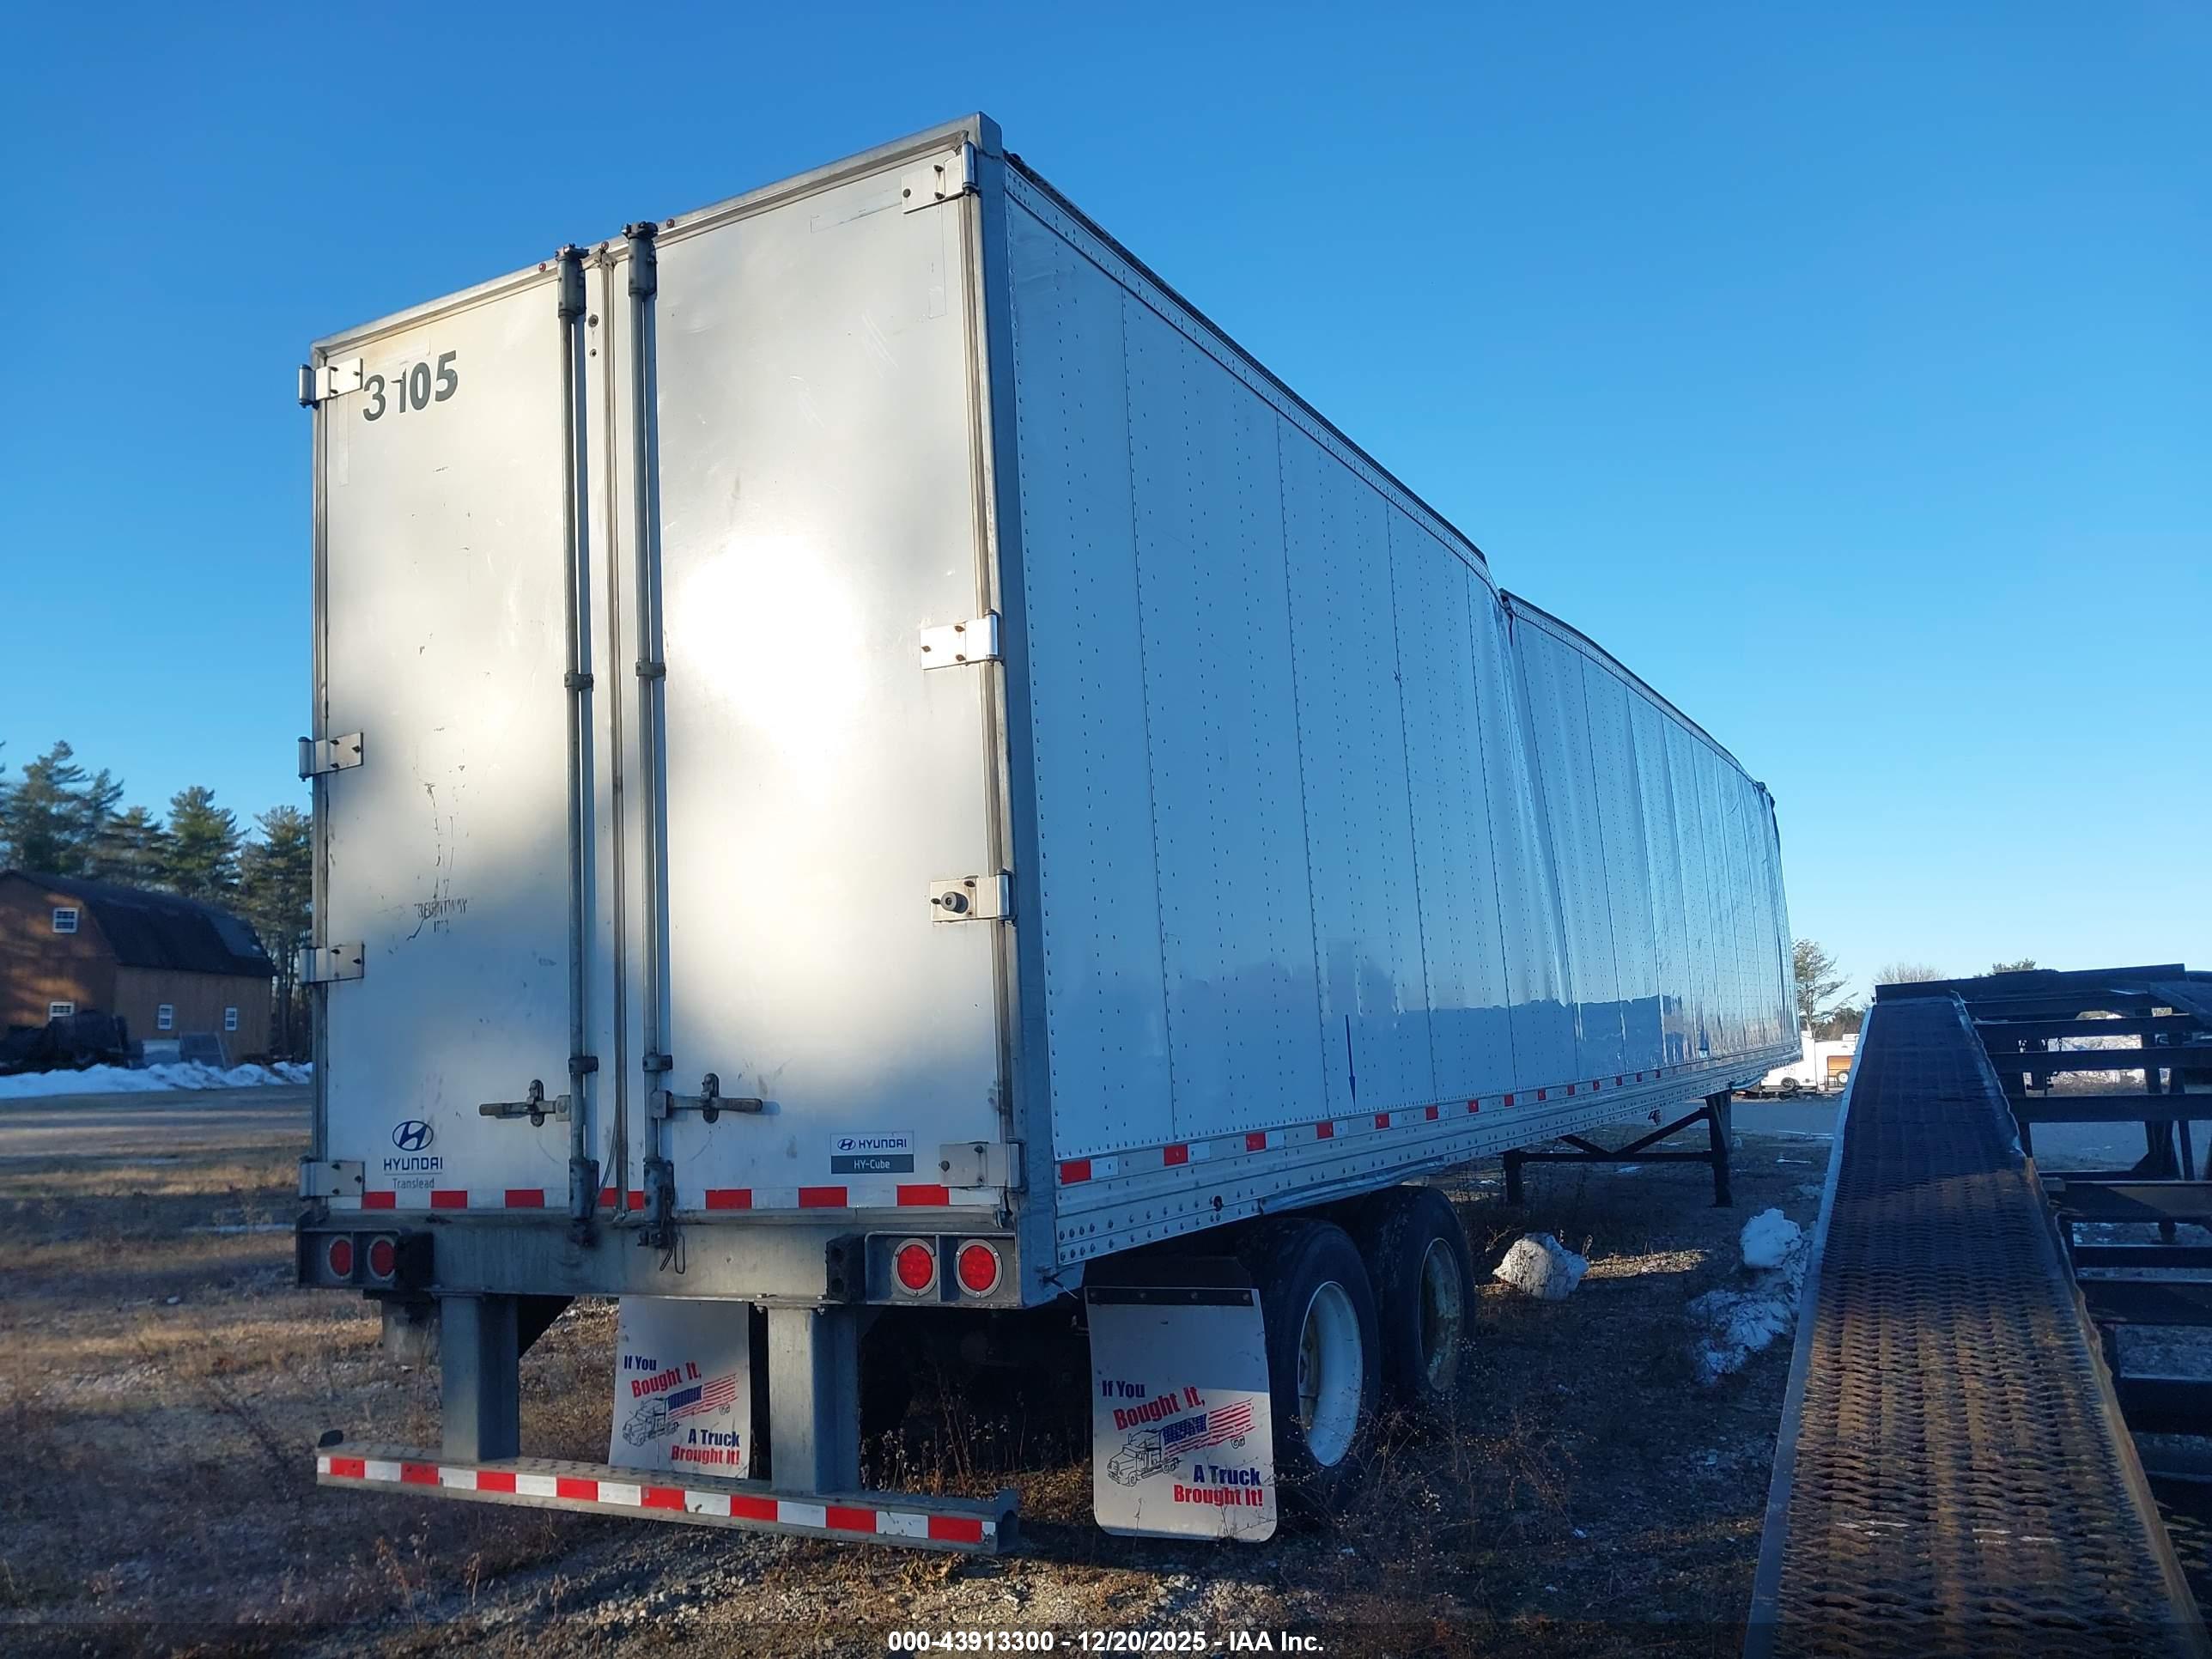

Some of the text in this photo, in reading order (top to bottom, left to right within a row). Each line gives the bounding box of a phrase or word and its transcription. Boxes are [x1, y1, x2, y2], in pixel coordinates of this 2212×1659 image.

[362, 349, 459, 422] 3105
[859, 1139, 907, 1149] HYUNDAI
[383, 1157, 443, 1171] HYUNDAI
[854, 1159, 890, 1170] HY-Cube
[392, 1177, 434, 1189] Translead
[623, 1355, 657, 1371] If You
[631, 1361, 702, 1398] Bought It,
[1102, 1380, 1146, 1399] If You
[1113, 1386, 1206, 1431] Bought It,
[688, 1428, 740, 1448] A Truck
[671, 1445, 740, 1466] Brought It!
[1193, 1464, 1261, 1486] A Truck
[1173, 1485, 1263, 1507] Brought It!
